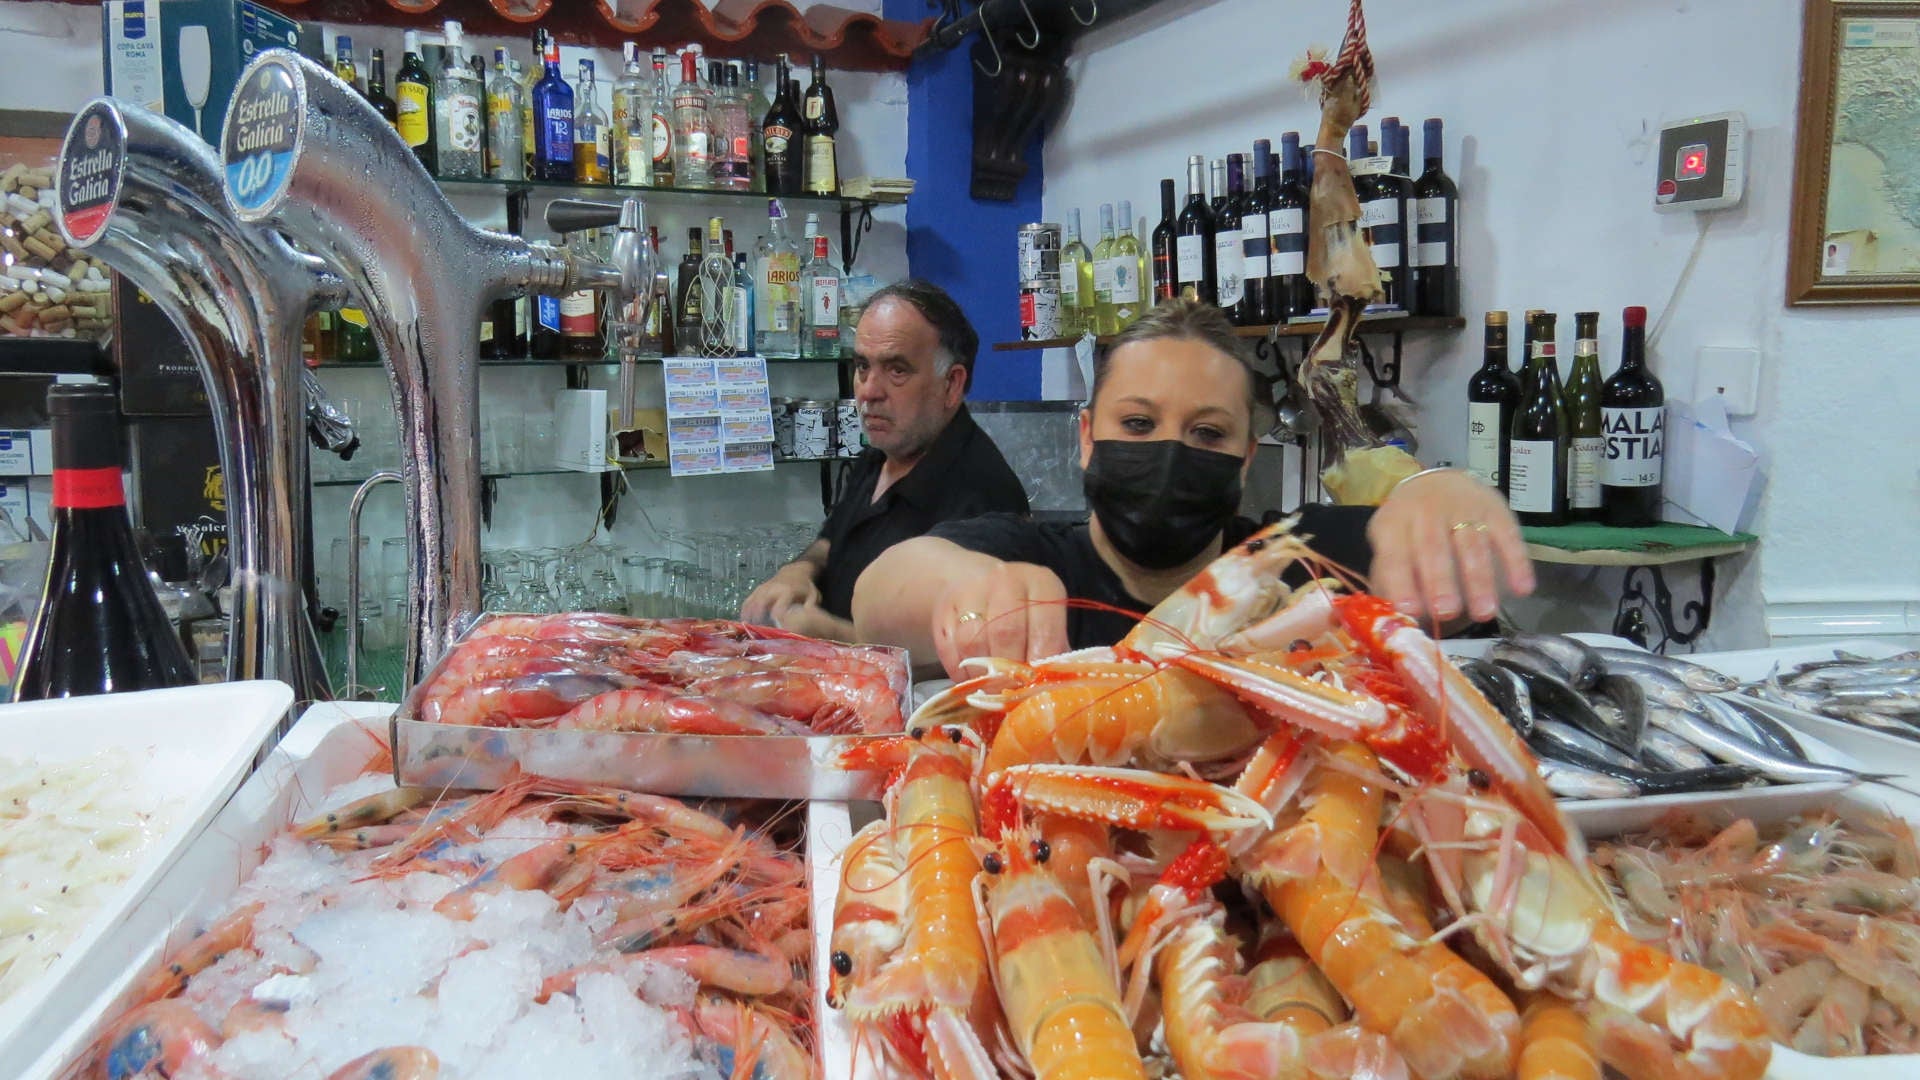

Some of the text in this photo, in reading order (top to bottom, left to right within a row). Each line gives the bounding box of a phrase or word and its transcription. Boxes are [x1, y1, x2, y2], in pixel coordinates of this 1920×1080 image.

[237, 90, 289, 124] Estrella
[547, 107, 572, 120] LARIOS
[236, 118, 284, 152] Galicia
[552, 121, 568, 135] 12
[69, 148, 113, 180] Estrella
[69, 174, 109, 206] Galicia
[768, 271, 800, 284] LARIOS
